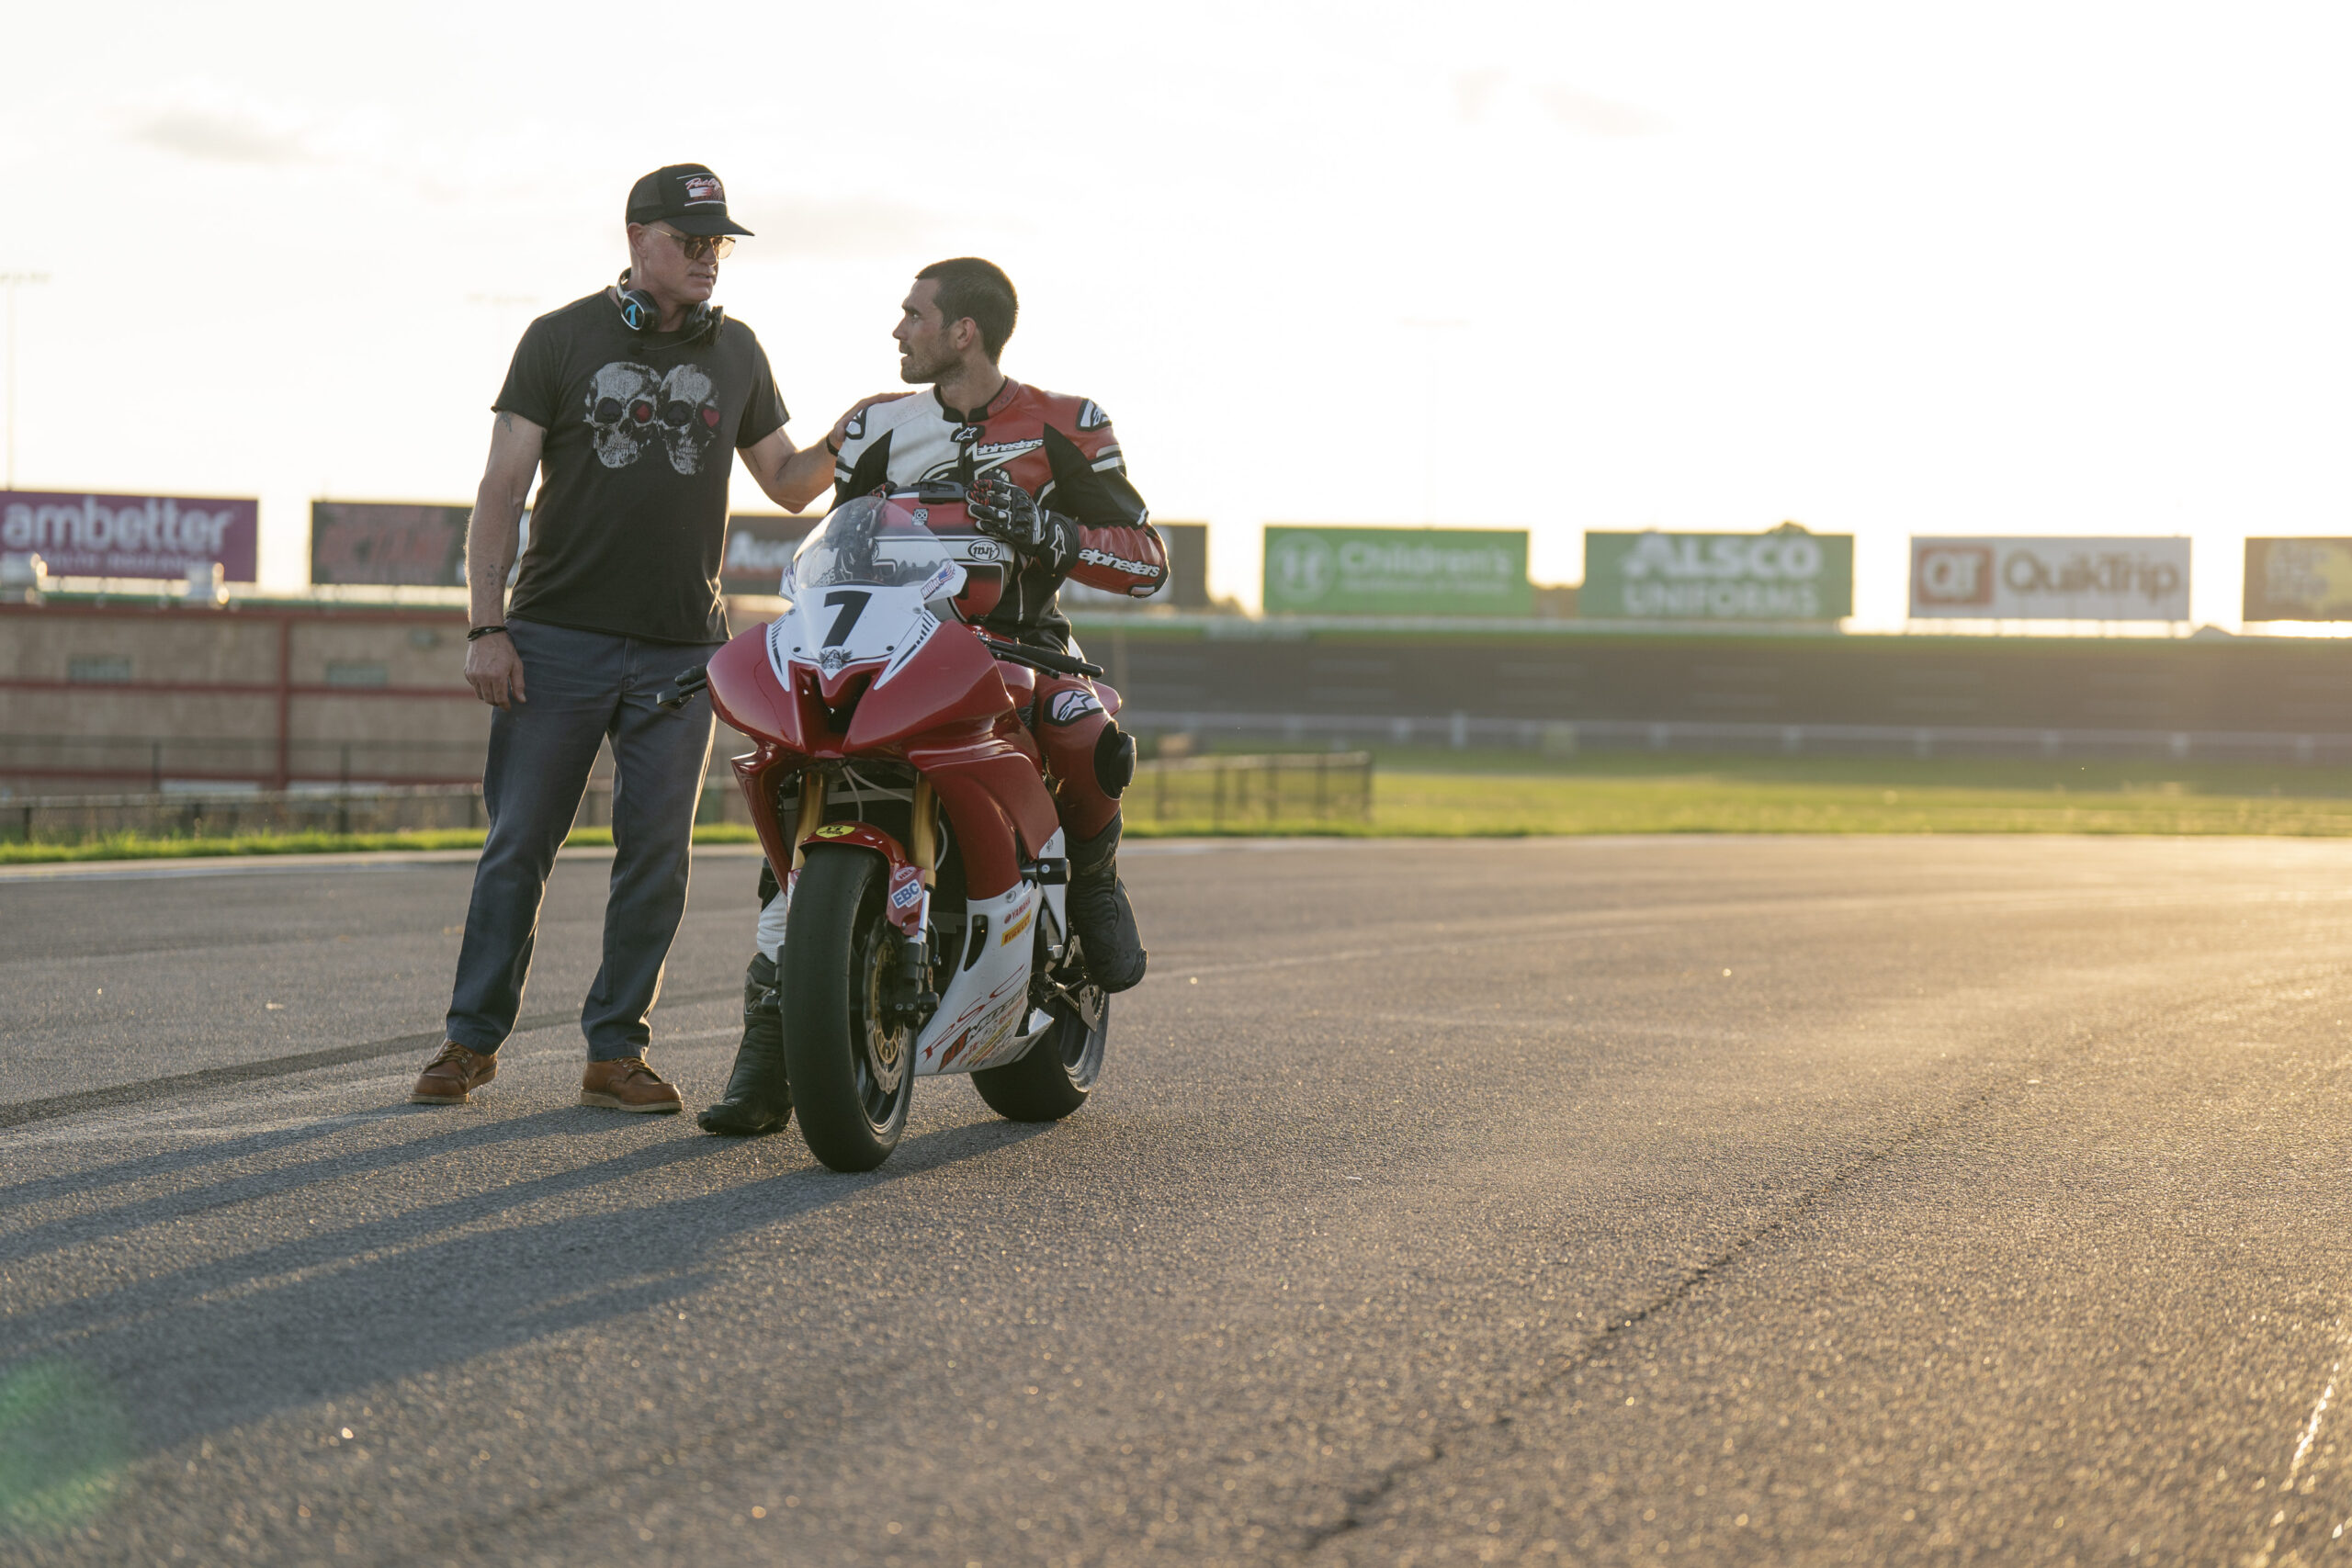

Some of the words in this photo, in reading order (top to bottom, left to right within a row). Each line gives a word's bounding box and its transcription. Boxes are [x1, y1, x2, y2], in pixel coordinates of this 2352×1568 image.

[2, 497, 233, 554] ambetter
[972, 546, 999, 558] Arai
[1079, 548, 1159, 578] alpinestars
[1622, 532, 1822, 579] ALSCO
[2003, 549, 2180, 605] QuikTrip
[821, 591, 873, 649] 7
[1622, 583, 1819, 617] UNIFORMS
[892, 882, 920, 907] EBC
